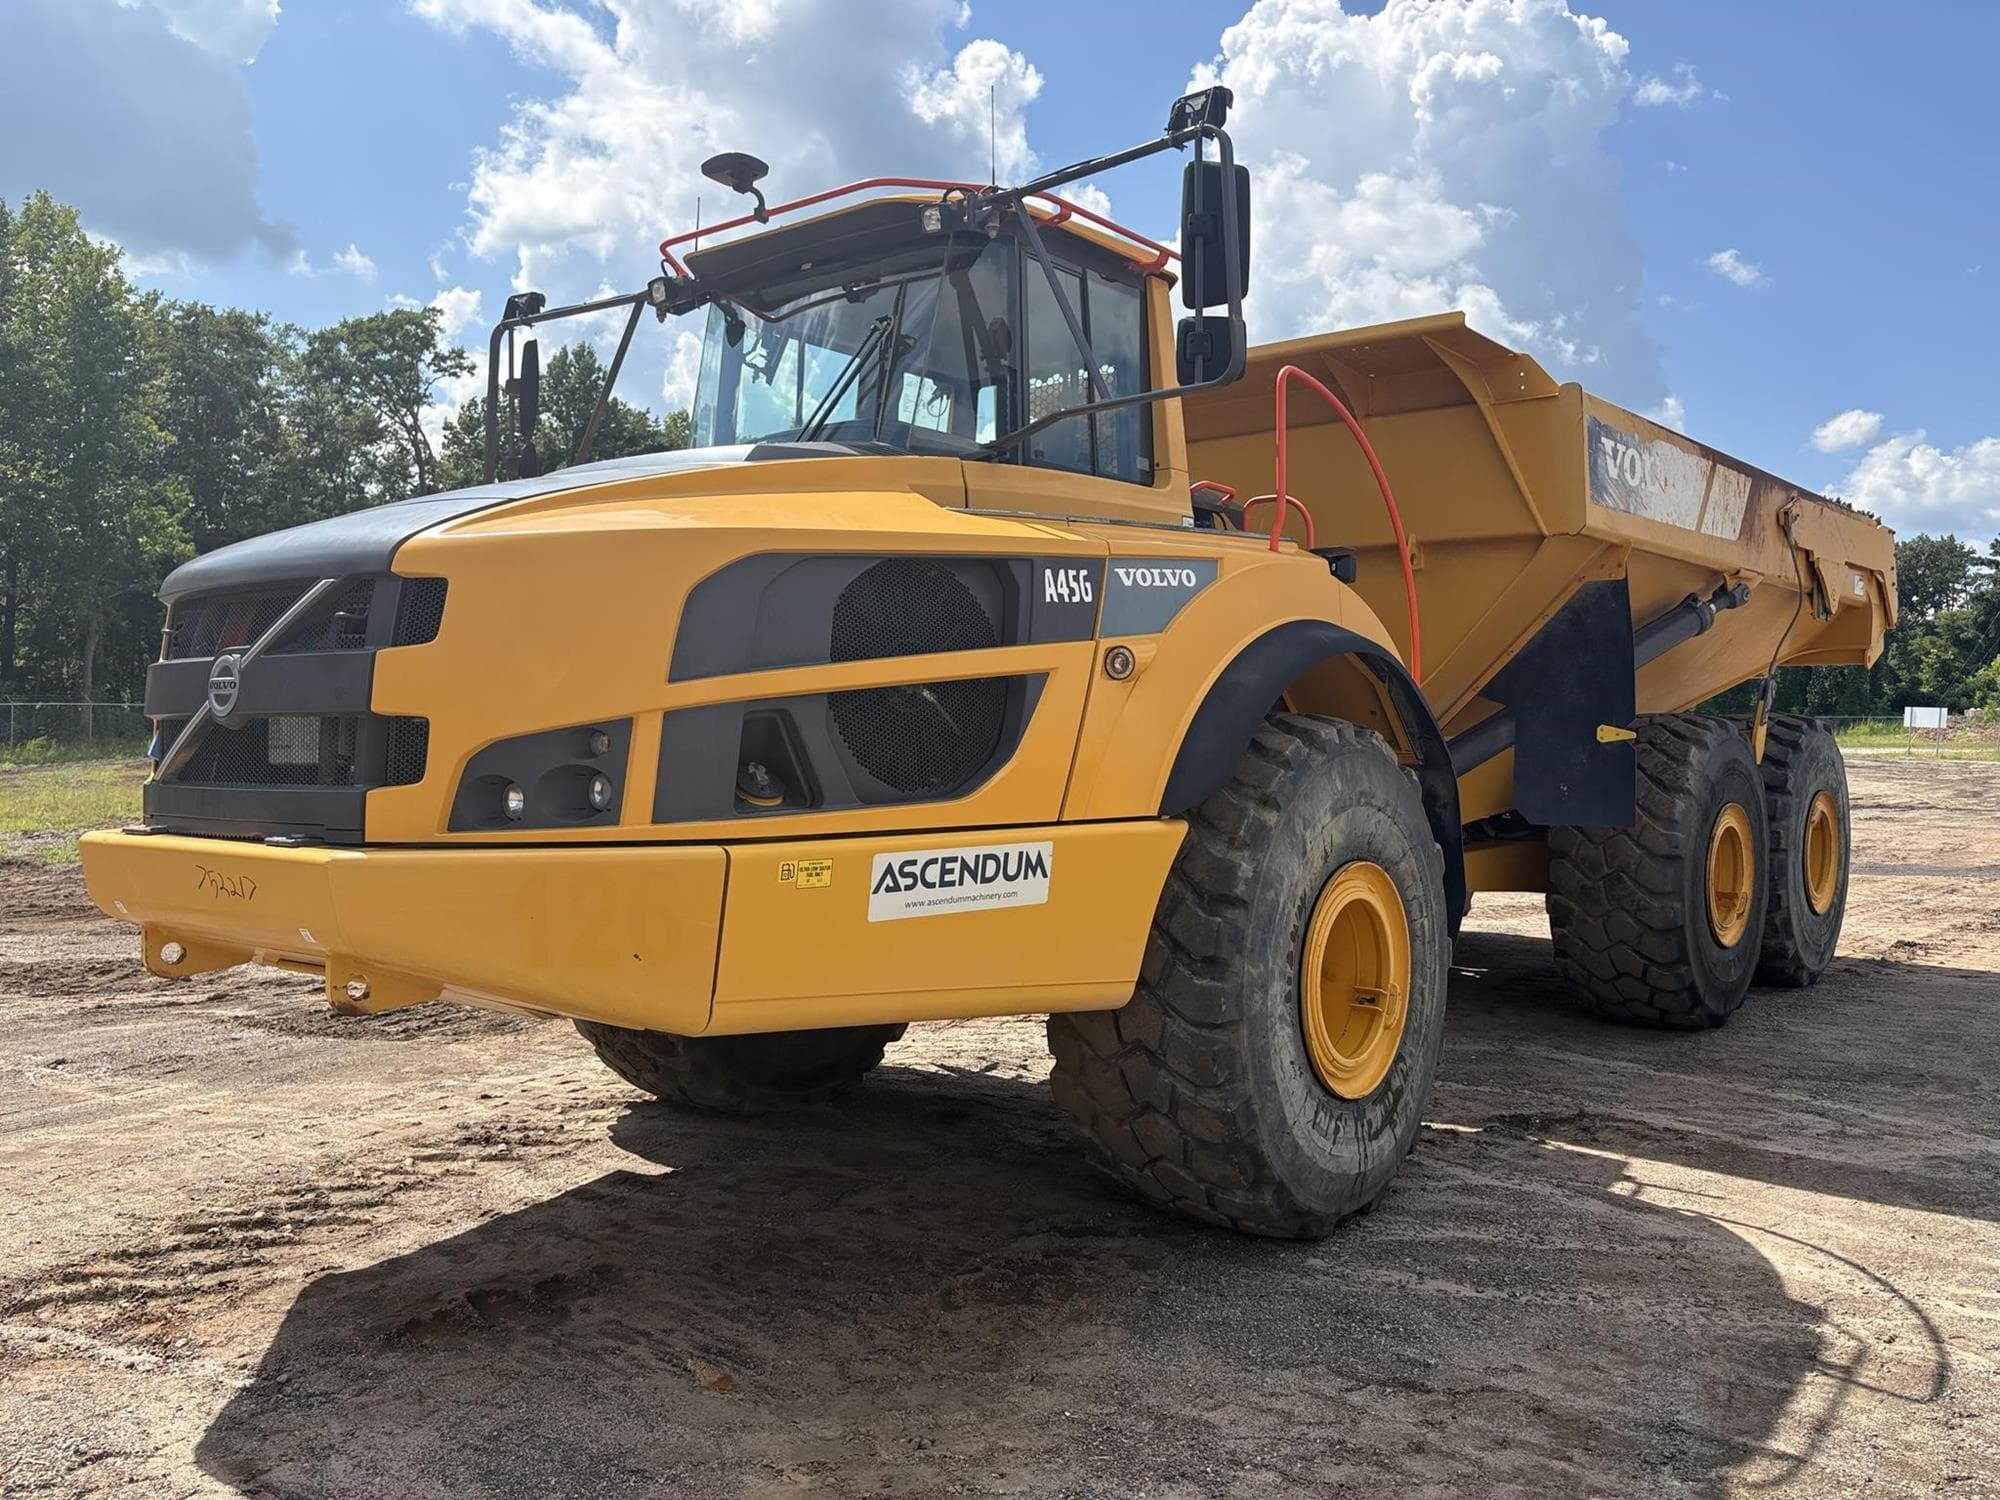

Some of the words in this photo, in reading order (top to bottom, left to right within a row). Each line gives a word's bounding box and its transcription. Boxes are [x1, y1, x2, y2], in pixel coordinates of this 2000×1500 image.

[1044, 568, 1093, 603] A45G
[1114, 568, 1197, 587] VOLVO
[872, 850, 1048, 895] ASCENDUM
[904, 890, 1018, 909] www.ascendummachinery.com
